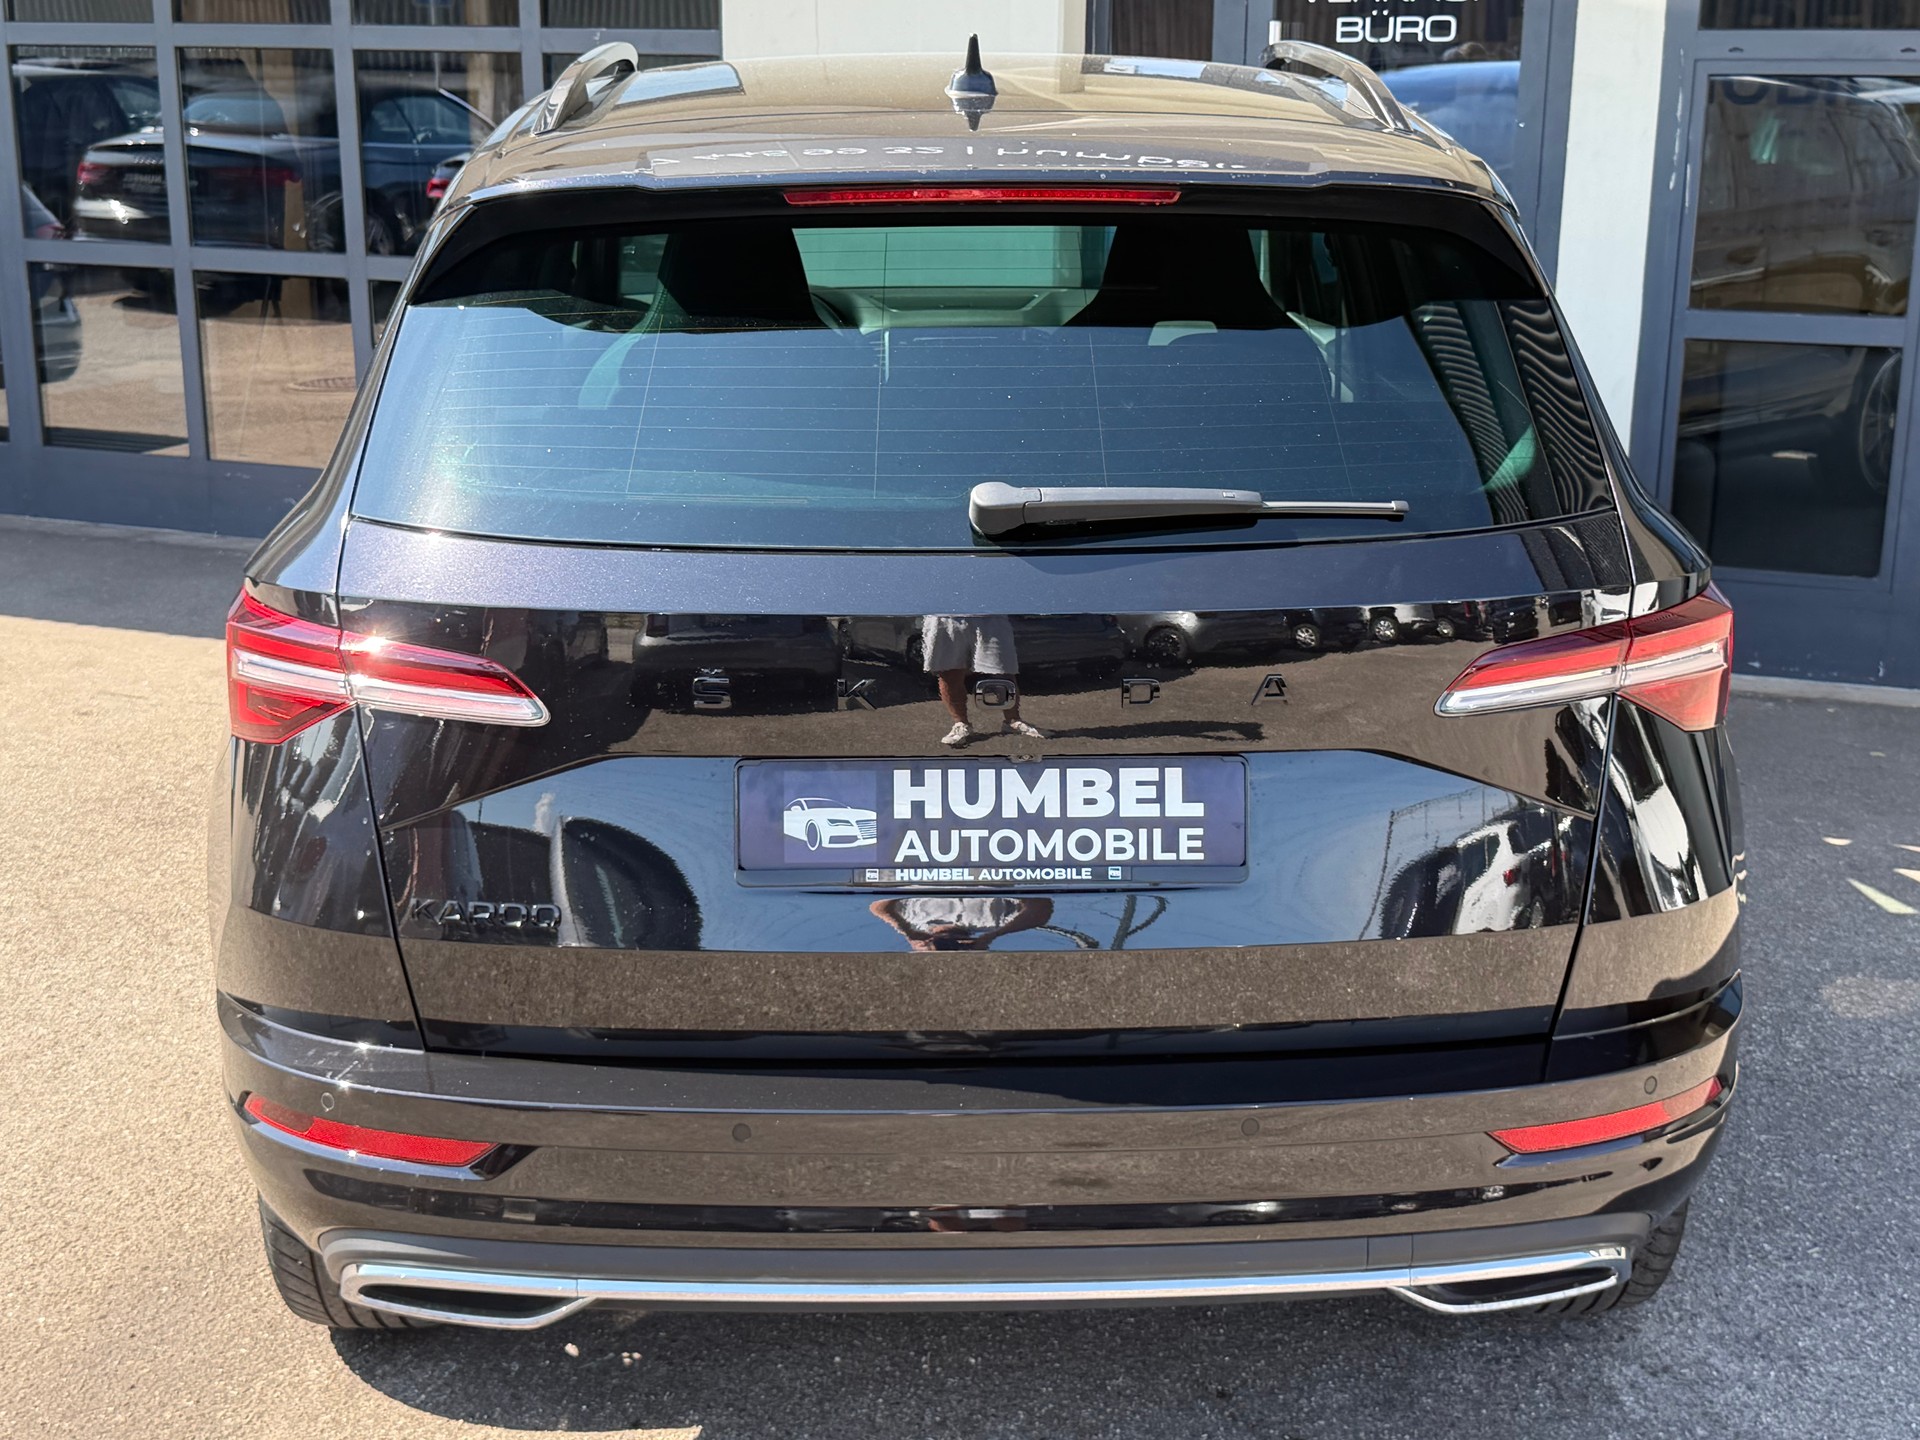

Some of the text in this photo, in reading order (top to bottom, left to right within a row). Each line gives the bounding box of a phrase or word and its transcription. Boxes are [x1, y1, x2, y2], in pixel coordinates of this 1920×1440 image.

[1335, 9, 1457, 43] BÜRO
[692, 667, 1288, 711] ŠKODA
[893, 768, 1205, 820] HUMBEL
[894, 828, 1205, 863] AUTOMOBILE
[895, 868, 1093, 882] HUMBEL AUTOMOBILE
